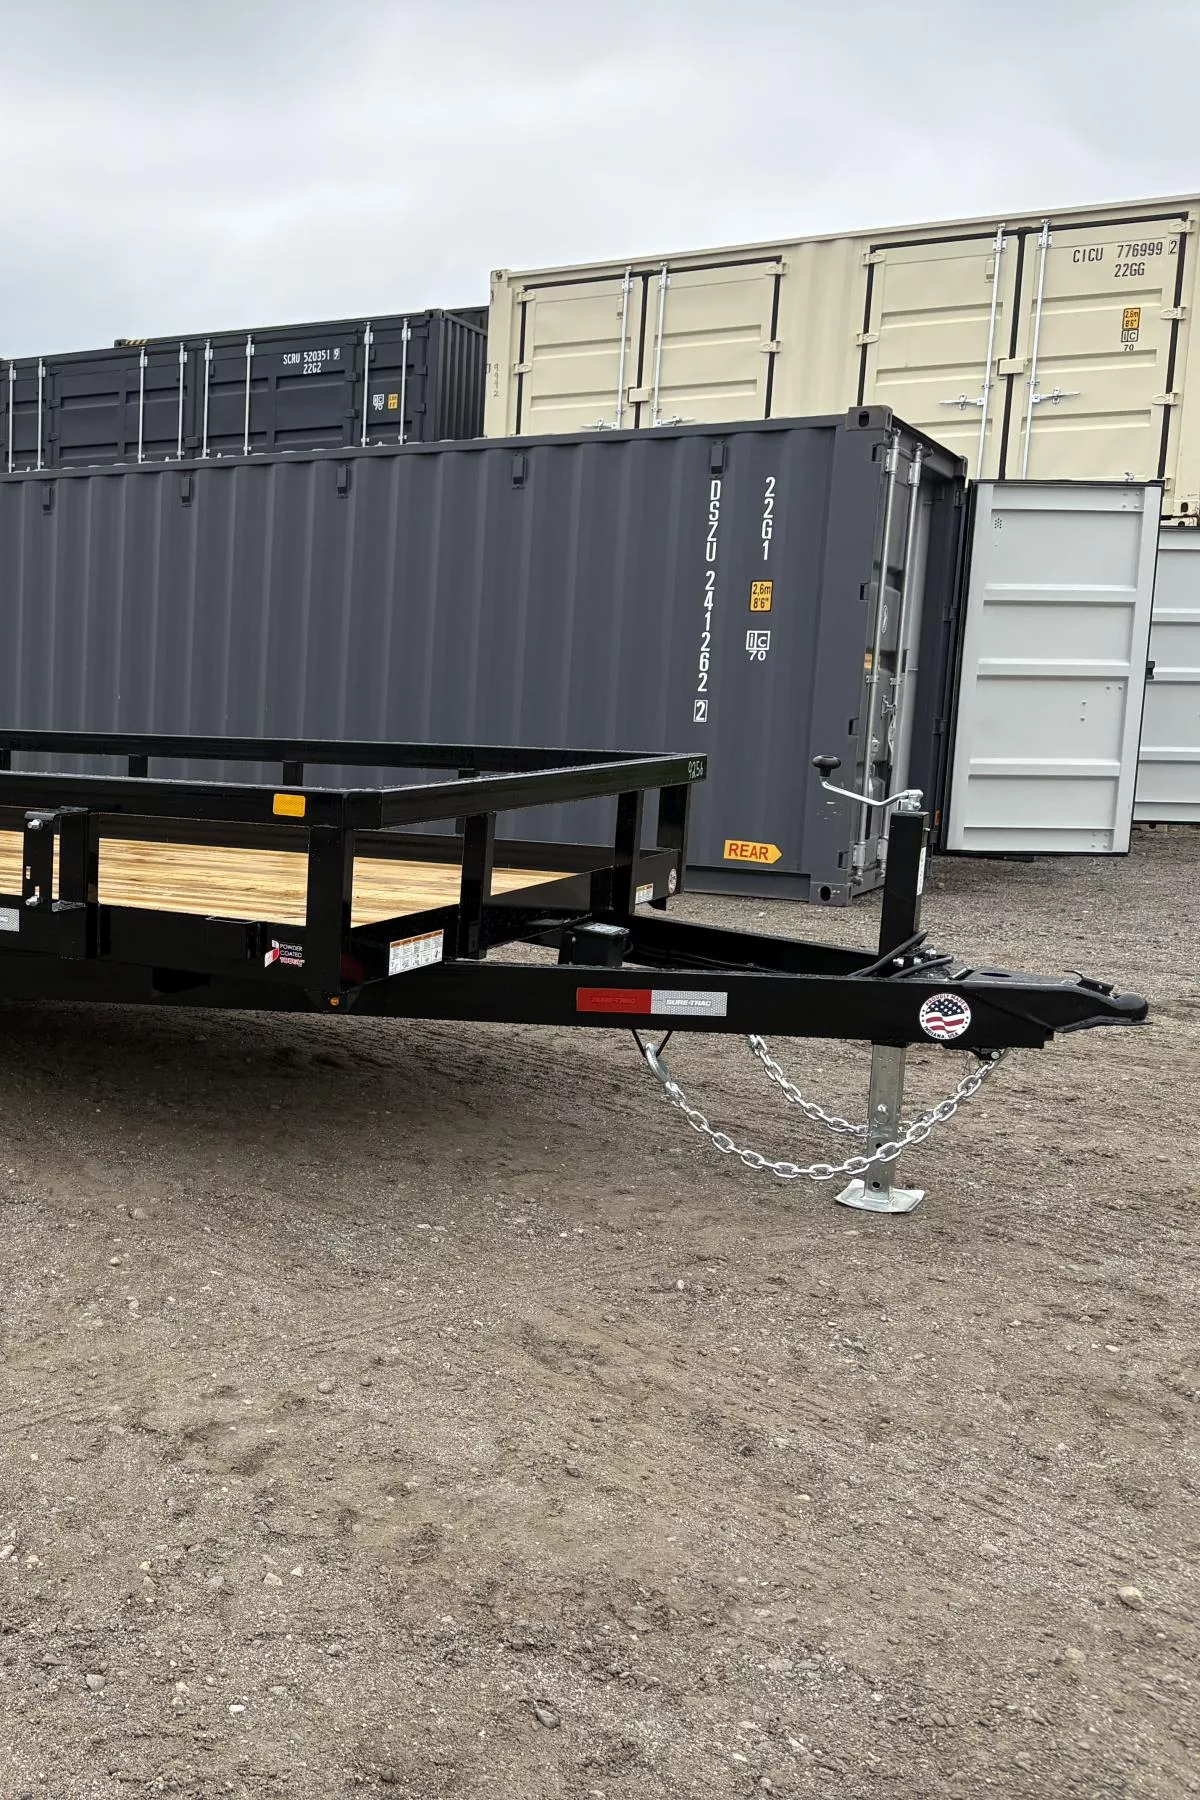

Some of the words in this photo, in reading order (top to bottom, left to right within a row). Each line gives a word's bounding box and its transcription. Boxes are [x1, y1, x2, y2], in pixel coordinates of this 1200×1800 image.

[1073, 248, 1104, 263] CICU
[1117, 242, 1163, 259] 776999
[1168, 240, 1178, 255] 2
[1114, 262, 1146, 278] 22GG
[283, 353, 301, 365] SCRU
[303, 349, 330, 363] 520351
[333, 348, 340, 360] 9
[303, 362, 322, 374] 22G2
[705, 480, 722, 562] DSZU
[761, 476, 776, 561] 22G1
[697, 570, 716, 693] 241262
[749, 651, 767, 661] 70
[694, 700, 707, 722] 2
[728, 843, 769, 860] REAR
[665, 998, 712, 1007] SURE-TRAC
